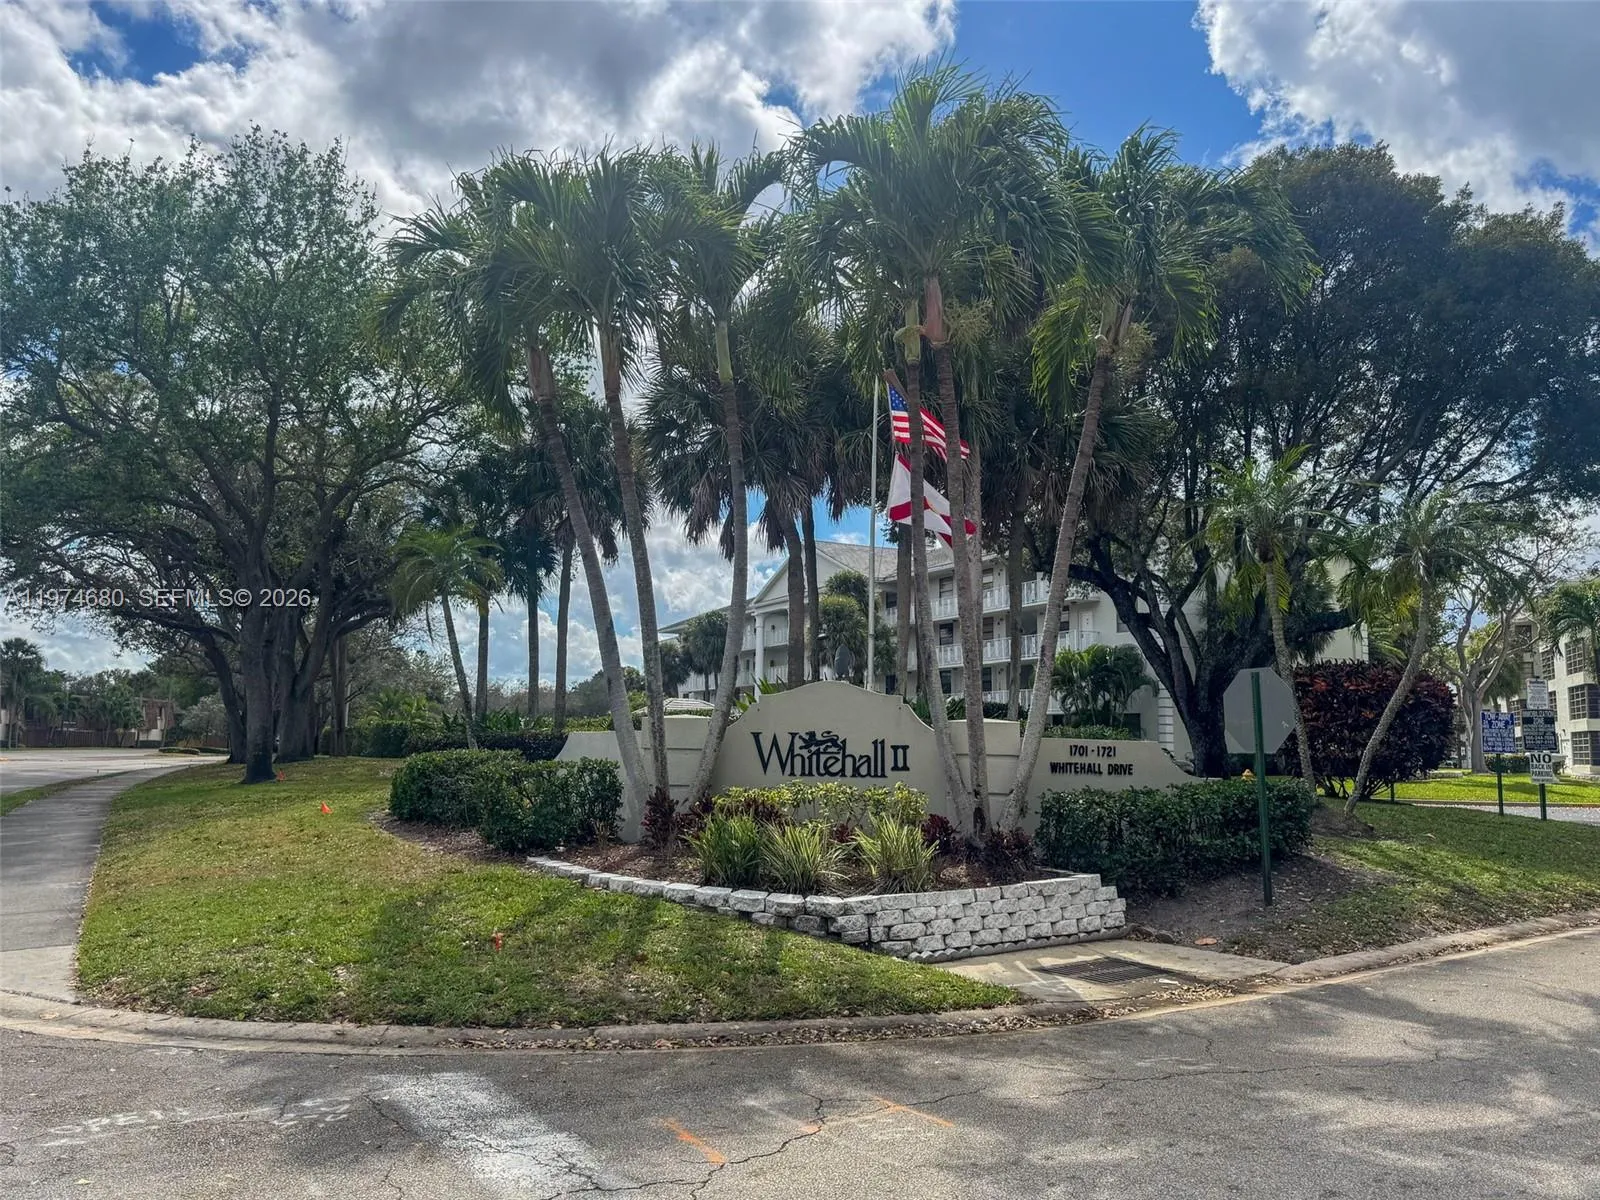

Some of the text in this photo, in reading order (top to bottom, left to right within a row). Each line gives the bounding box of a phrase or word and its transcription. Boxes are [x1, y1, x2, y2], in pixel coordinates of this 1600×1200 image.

[750, 731, 910, 779] Whitehall II
[1069, 745, 1088, 757] 1701
[1097, 746, 1116, 757] 1721
[1530, 753, 1552, 763] NO
[1049, 761, 1134, 776] WHITEHALL DRIVE
